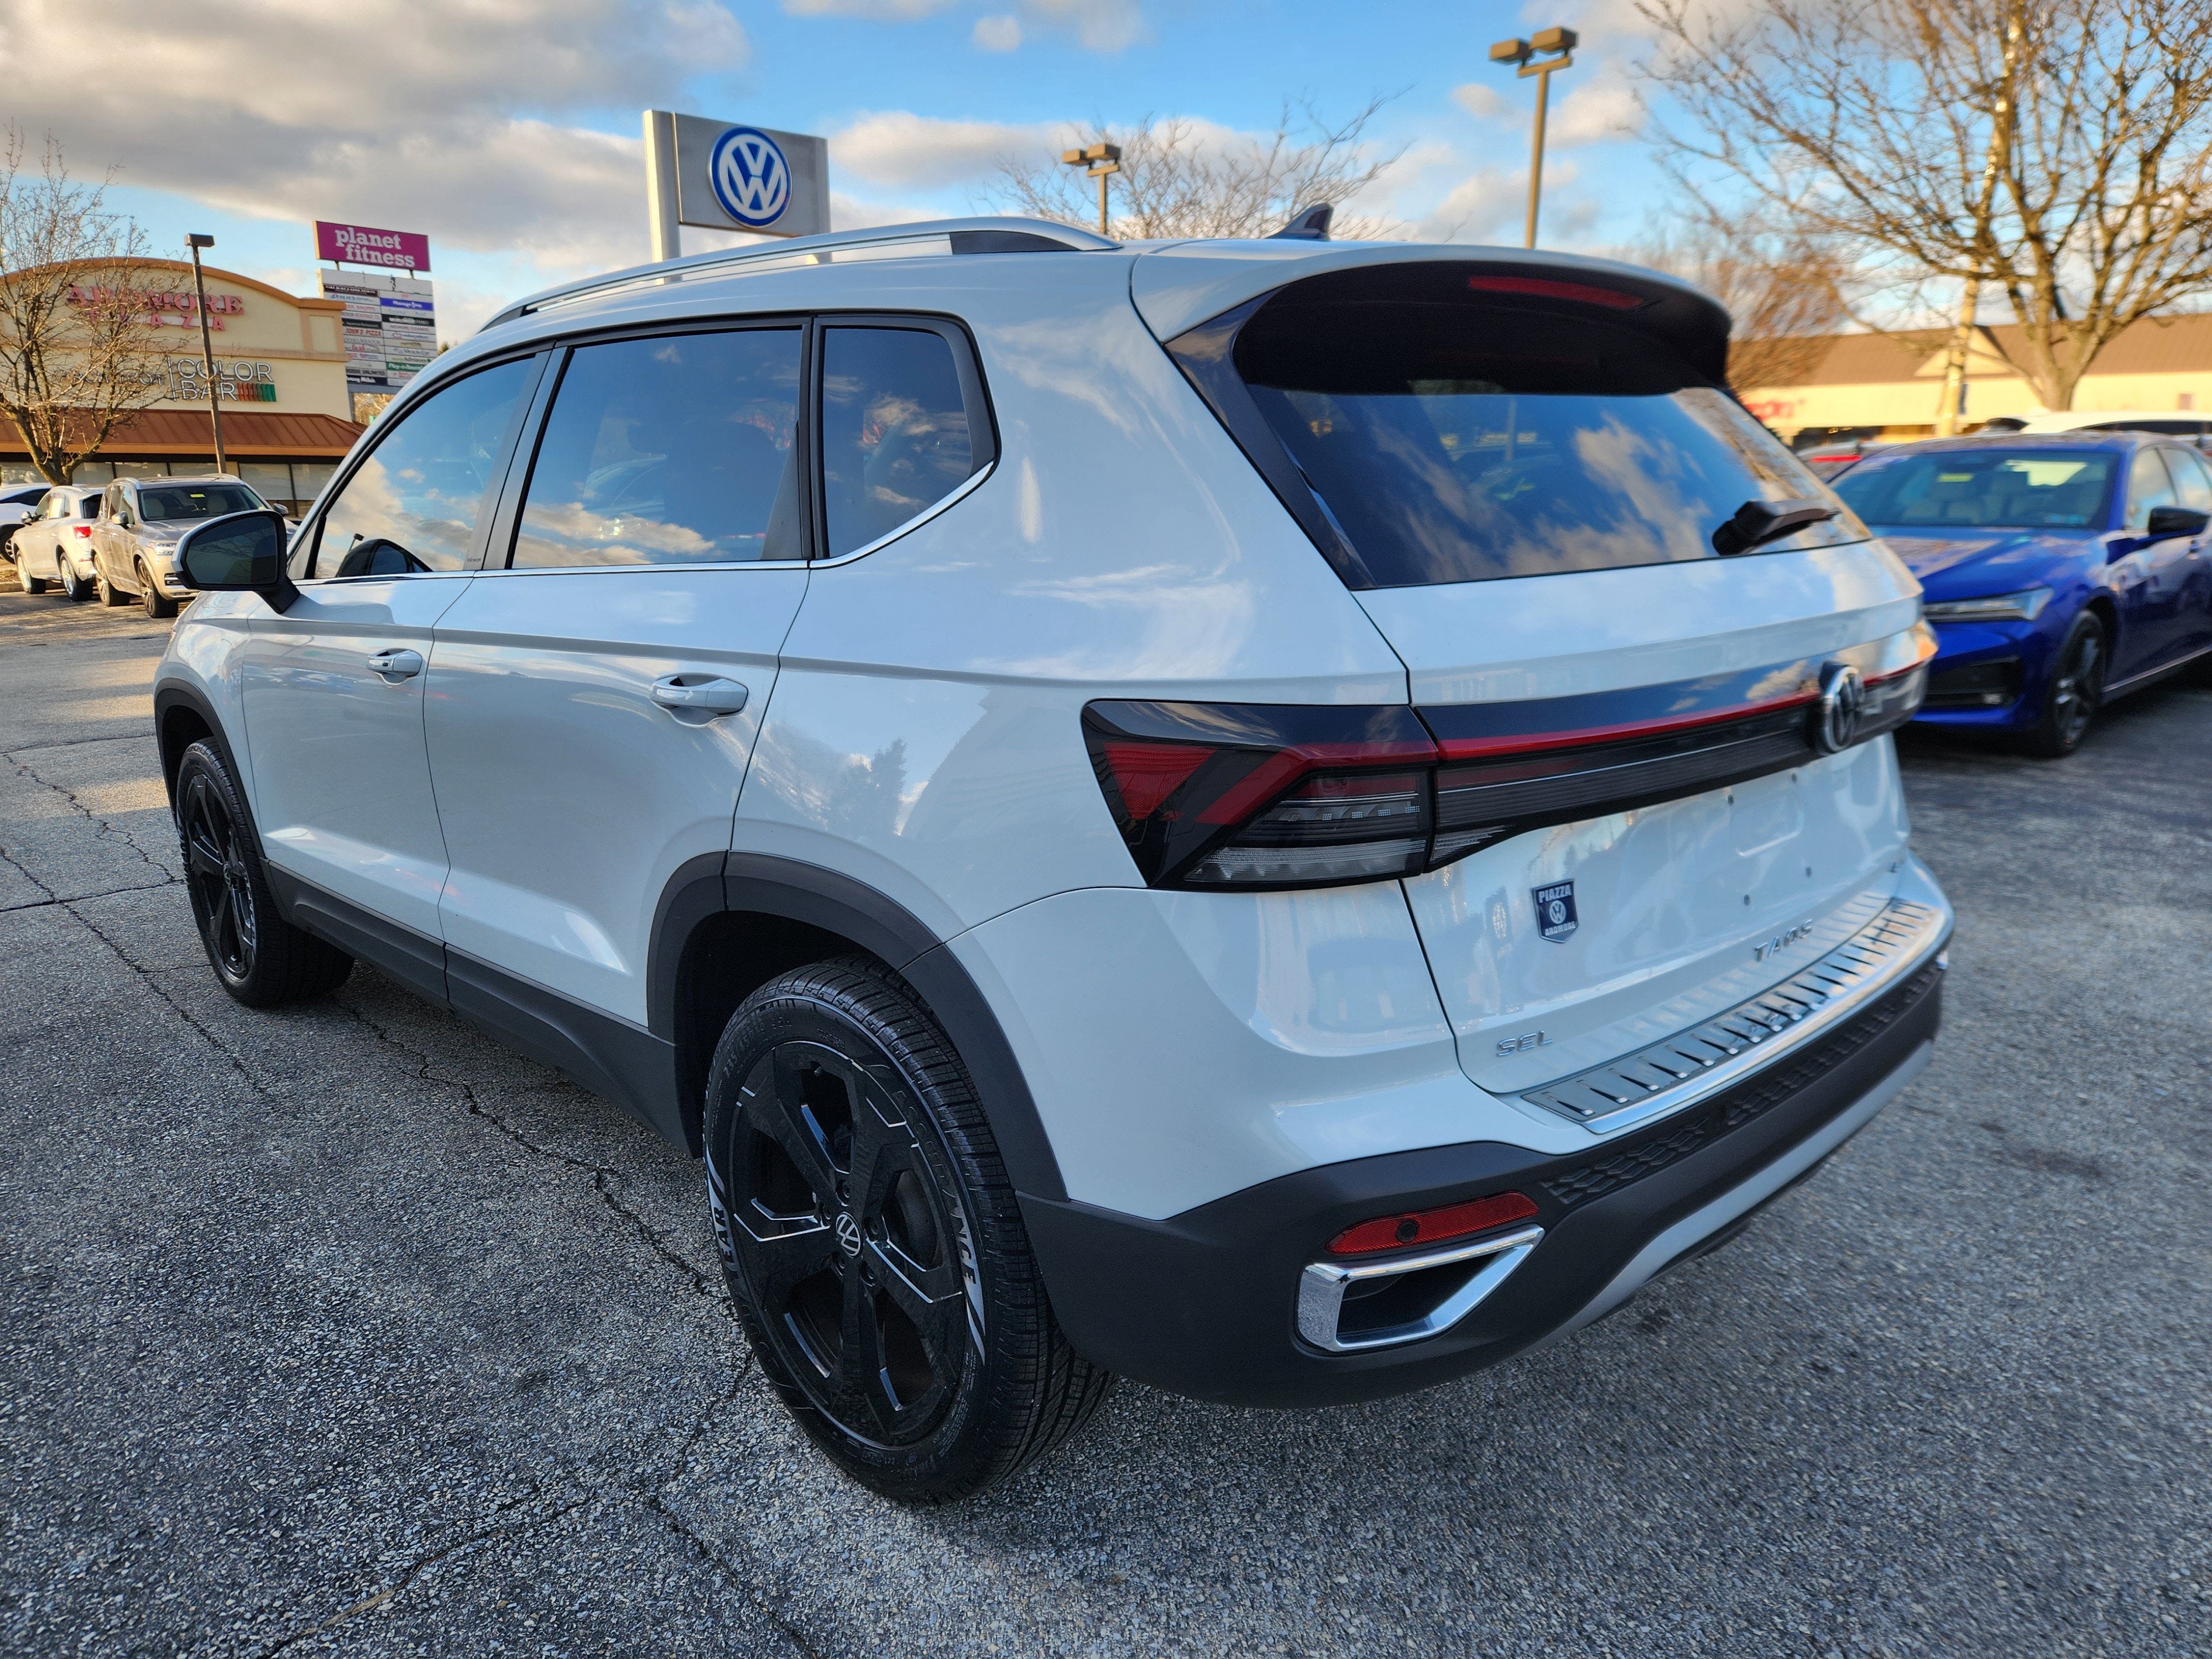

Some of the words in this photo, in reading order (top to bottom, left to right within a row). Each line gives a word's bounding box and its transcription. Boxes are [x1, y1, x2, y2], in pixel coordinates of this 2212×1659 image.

[335, 227, 402, 250] planet
[346, 243, 415, 268] fitness
[176, 358, 275, 383] COLOR
[1538, 884, 1572, 904] PIAZZA
[1545, 921, 1576, 936] ARDMORE
[1754, 918, 1813, 962] TAOS
[1496, 1030, 1553, 1057] SEL
